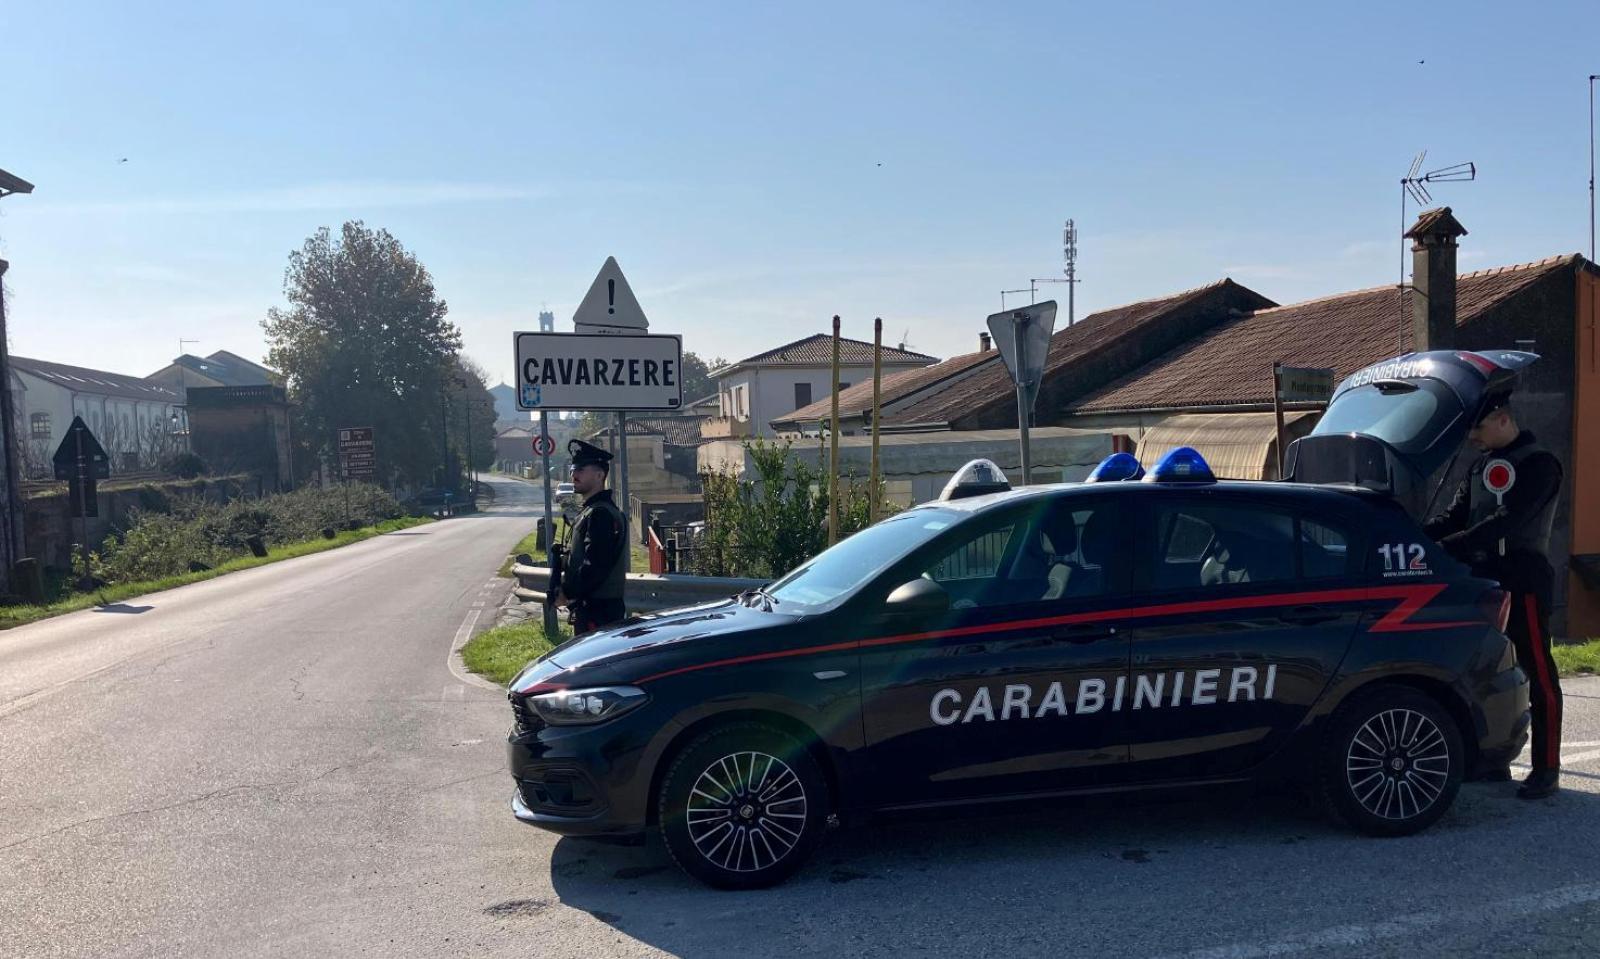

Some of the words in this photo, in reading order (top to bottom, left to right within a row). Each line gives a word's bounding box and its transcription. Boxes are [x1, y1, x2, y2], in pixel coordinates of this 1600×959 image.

[523, 358, 675, 386] CAVARZERE
[1377, 543, 1427, 570] 112
[929, 664, 1278, 726] CARABINIERI
